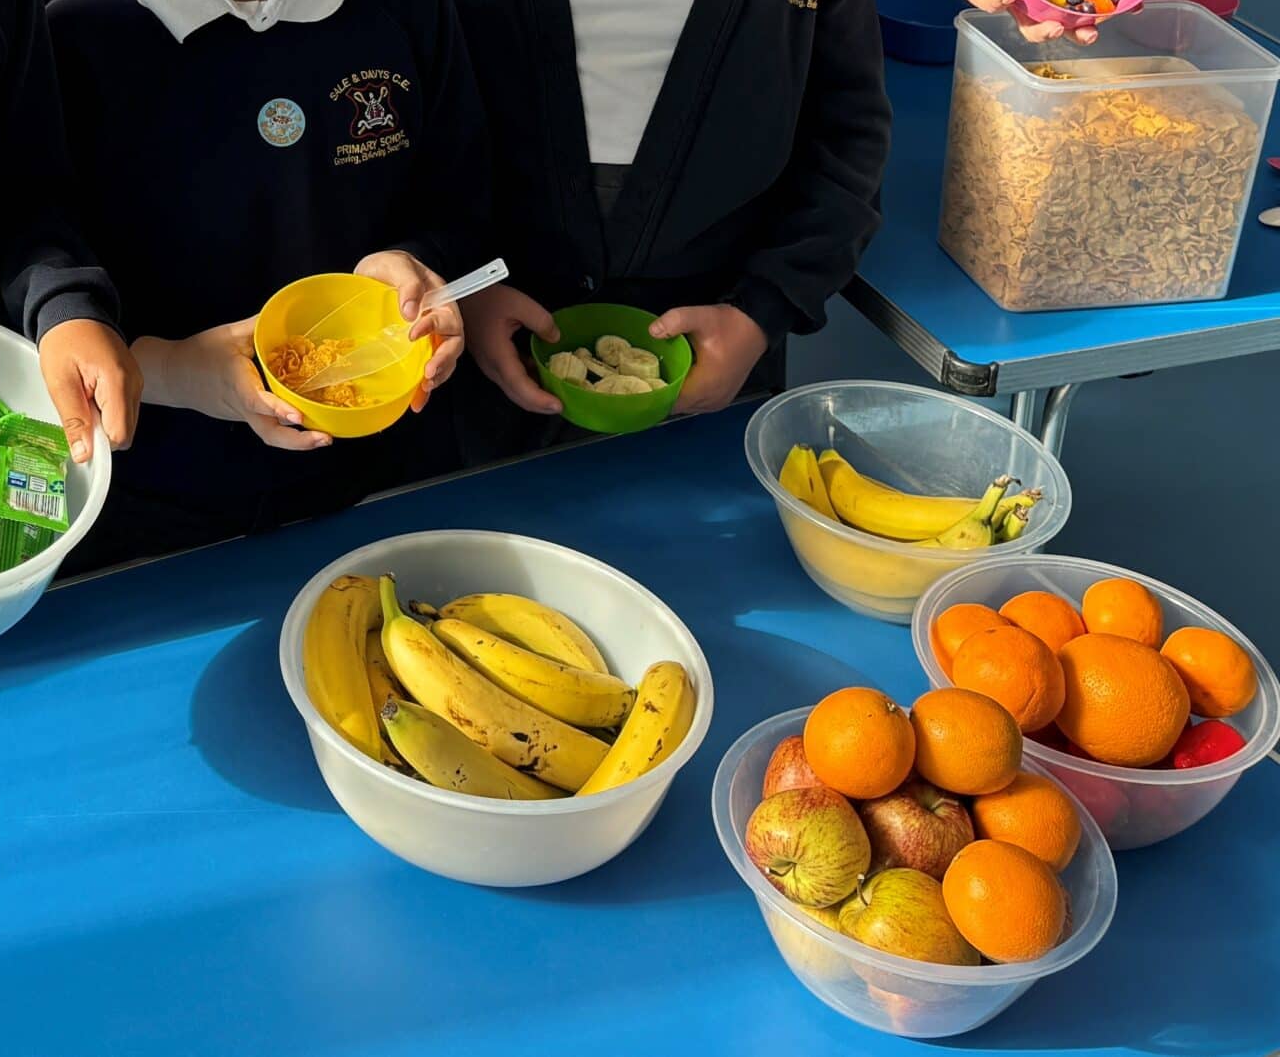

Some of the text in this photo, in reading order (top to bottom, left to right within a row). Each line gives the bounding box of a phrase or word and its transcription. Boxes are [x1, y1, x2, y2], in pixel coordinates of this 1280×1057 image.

[329, 78, 351, 101] SALE
[352, 73, 361, 83] &
[336, 129, 406, 156] PRIMARY SCHOL
